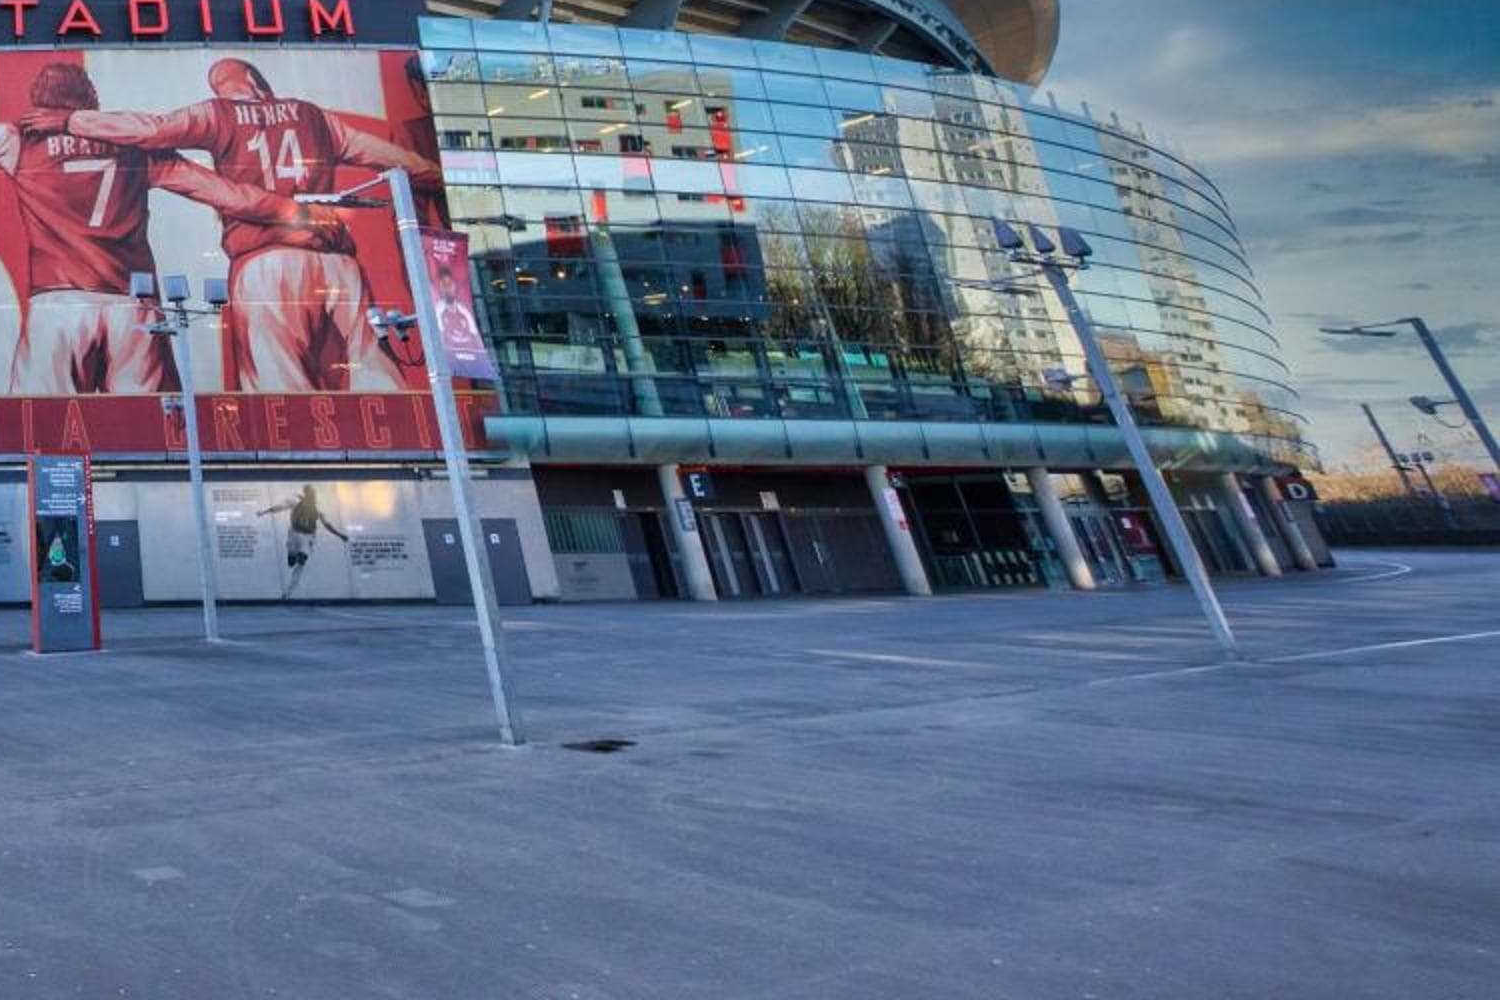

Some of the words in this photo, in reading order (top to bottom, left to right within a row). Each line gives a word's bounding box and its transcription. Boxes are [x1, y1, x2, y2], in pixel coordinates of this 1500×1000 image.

[234, 103, 299, 125] HENRY
[247, 128, 308, 191] 14
[63, 159, 116, 228] 7
[689, 473, 705, 497] E
[1286, 483, 1308, 499] D
